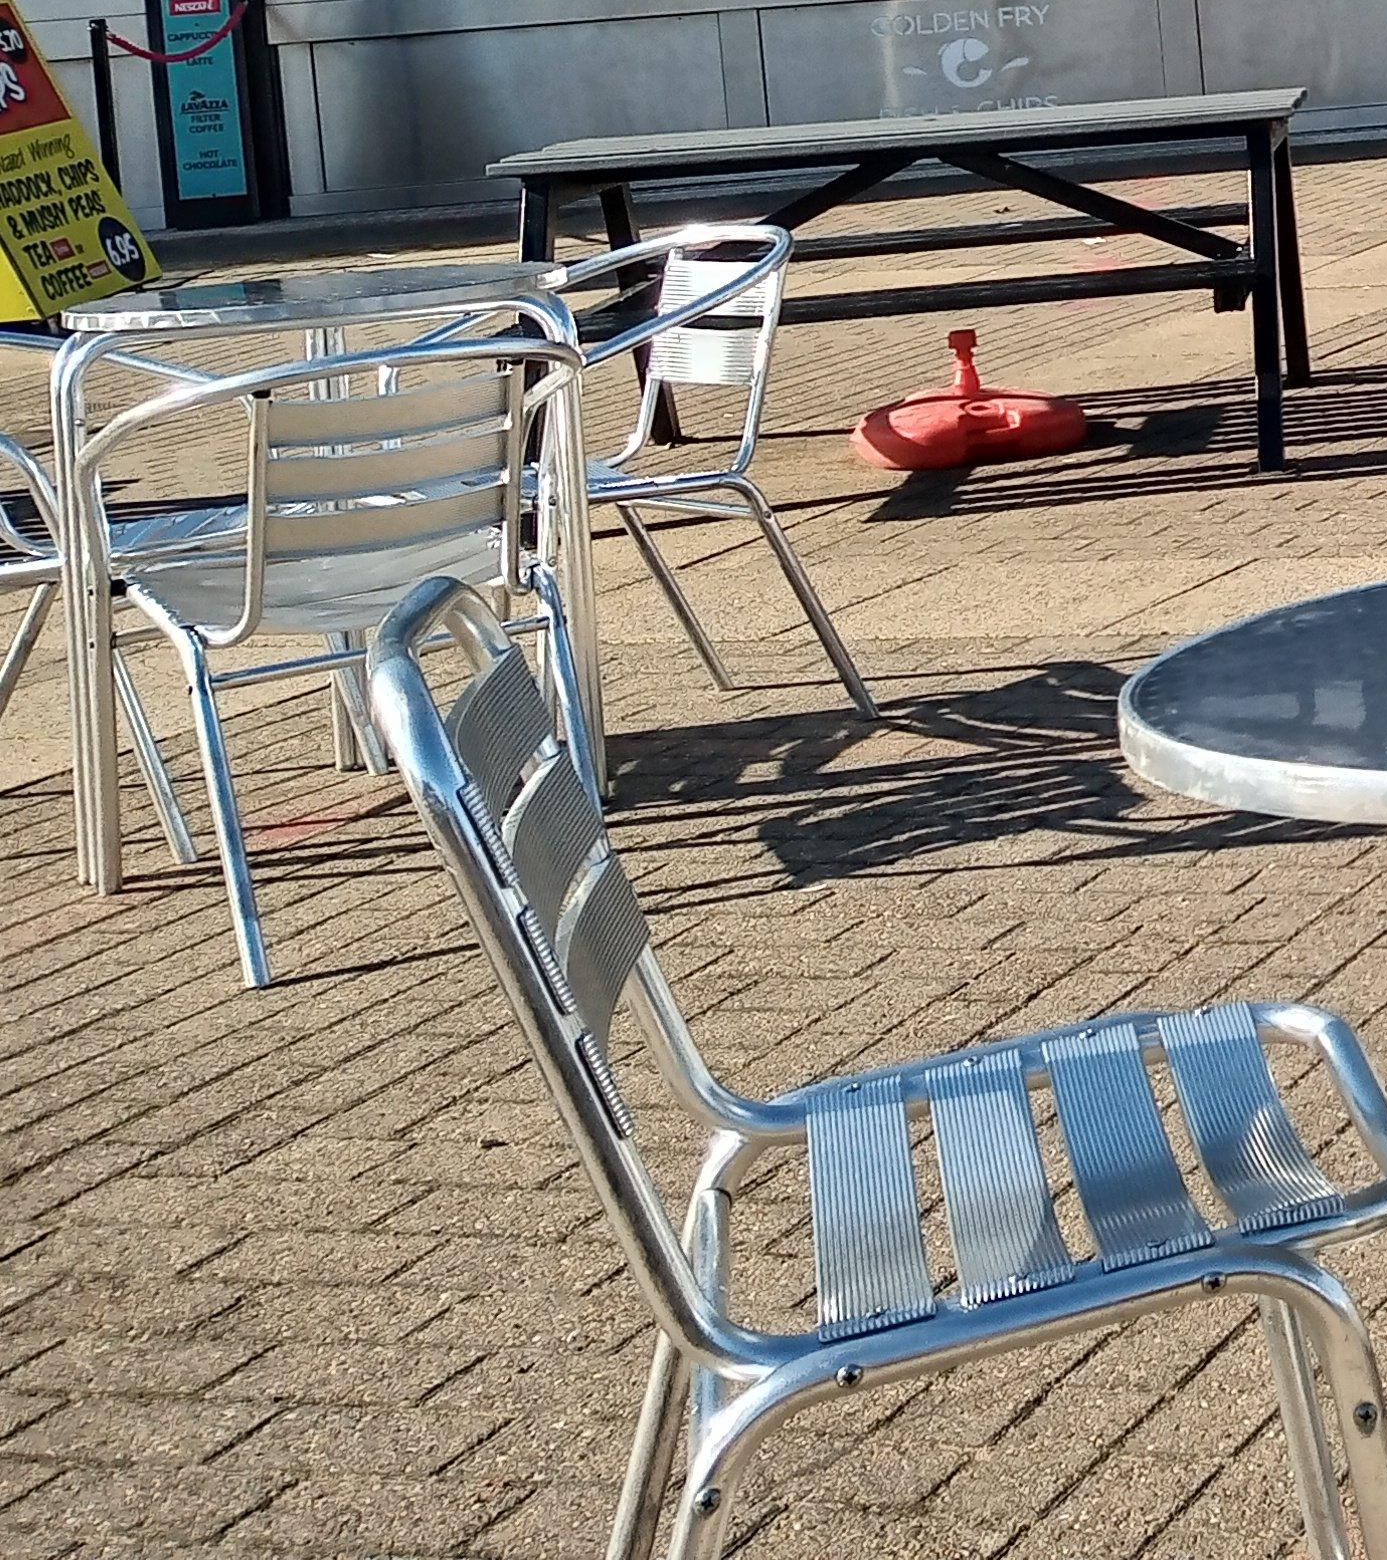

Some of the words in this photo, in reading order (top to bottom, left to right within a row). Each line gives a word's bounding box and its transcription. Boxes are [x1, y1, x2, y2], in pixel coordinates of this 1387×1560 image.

[870, 9, 989, 37] GOLDEN
[998, 4, 1051, 28] FRY
[28, 133, 75, 163] Winning
[199, 149, 219, 159] HOT
[57, 158, 101, 190] CHIPS
[183, 158, 238, 171] CHOCOLATE
[6, 213, 25, 241] &
[24, 199, 70, 235] MUSHY
[68, 190, 107, 220] PEAS
[23, 240, 51, 271] TEA
[107, 231, 140, 267] 6.95
[41, 263, 93, 301] COFFEE
